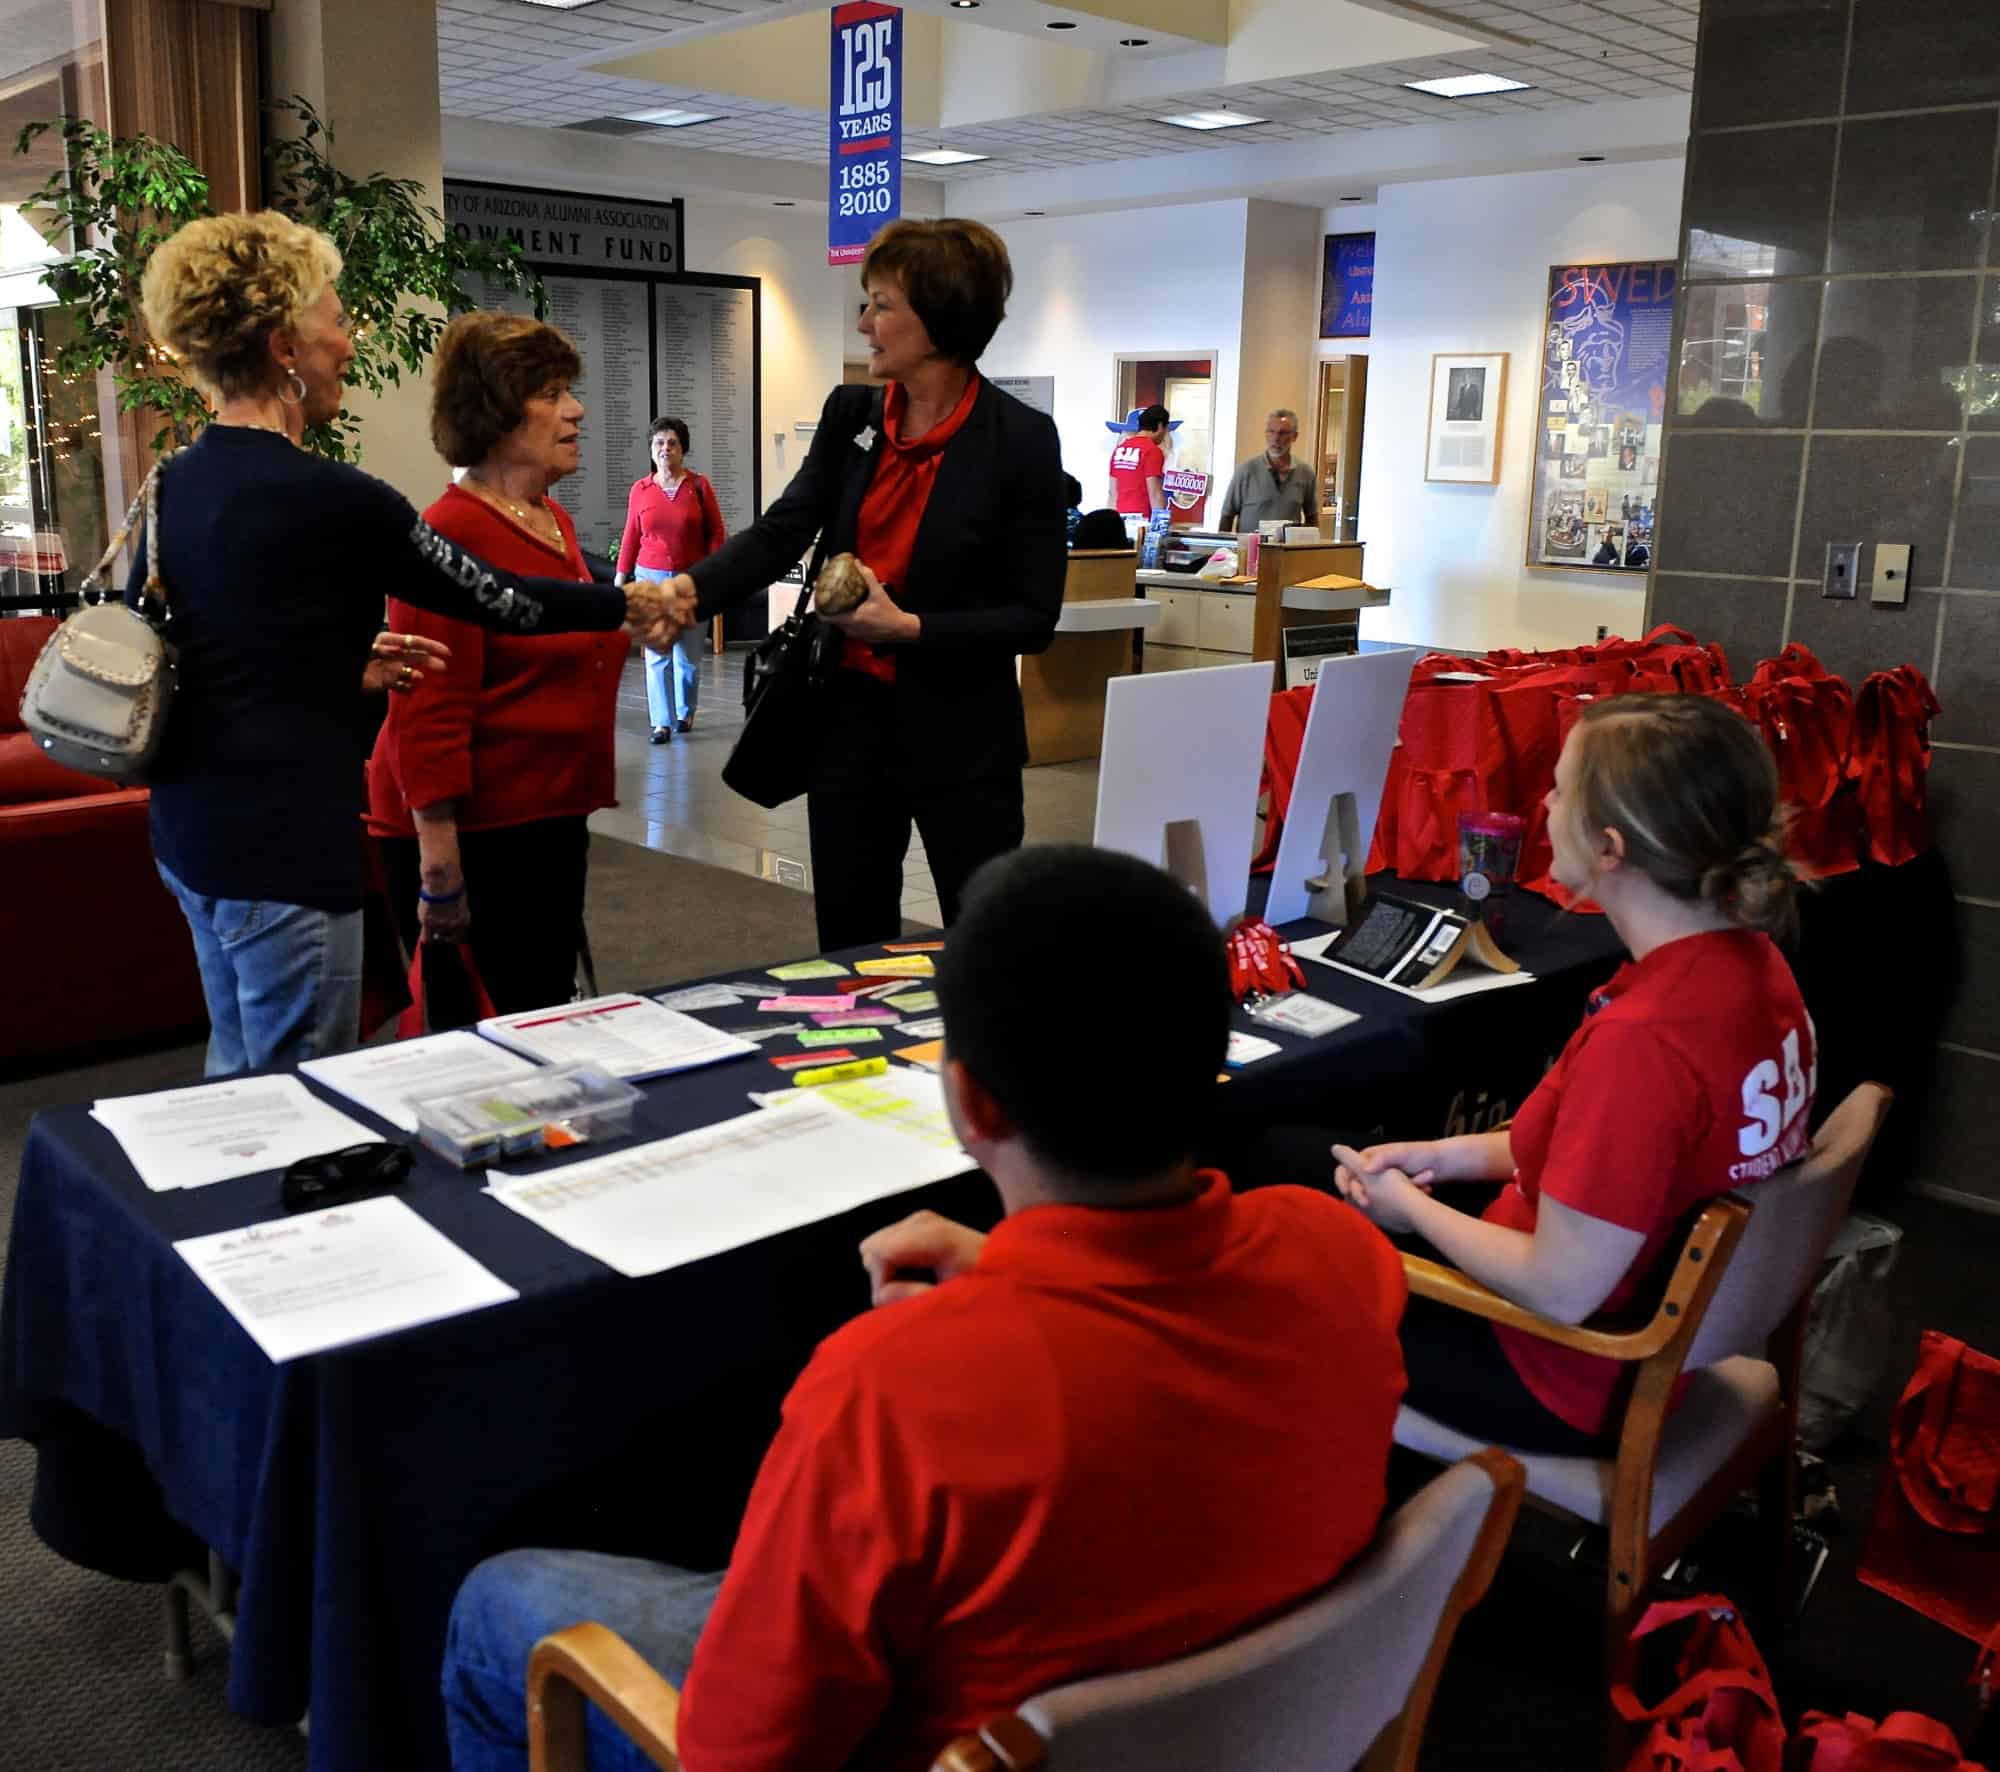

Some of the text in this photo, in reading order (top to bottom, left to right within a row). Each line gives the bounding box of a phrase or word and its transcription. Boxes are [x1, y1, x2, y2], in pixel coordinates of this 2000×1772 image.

[838, 19, 893, 117] 125
[838, 112, 893, 139] YEARS
[838, 160, 891, 190] 1885
[463, 195, 480, 213] OF
[484, 197, 539, 219] ARIZONA
[543, 203, 592, 226] ALUMNI
[595, 208, 670, 233] ASSOCIATION
[838, 188, 891, 217] 2010
[604, 236, 674, 263] FUND
